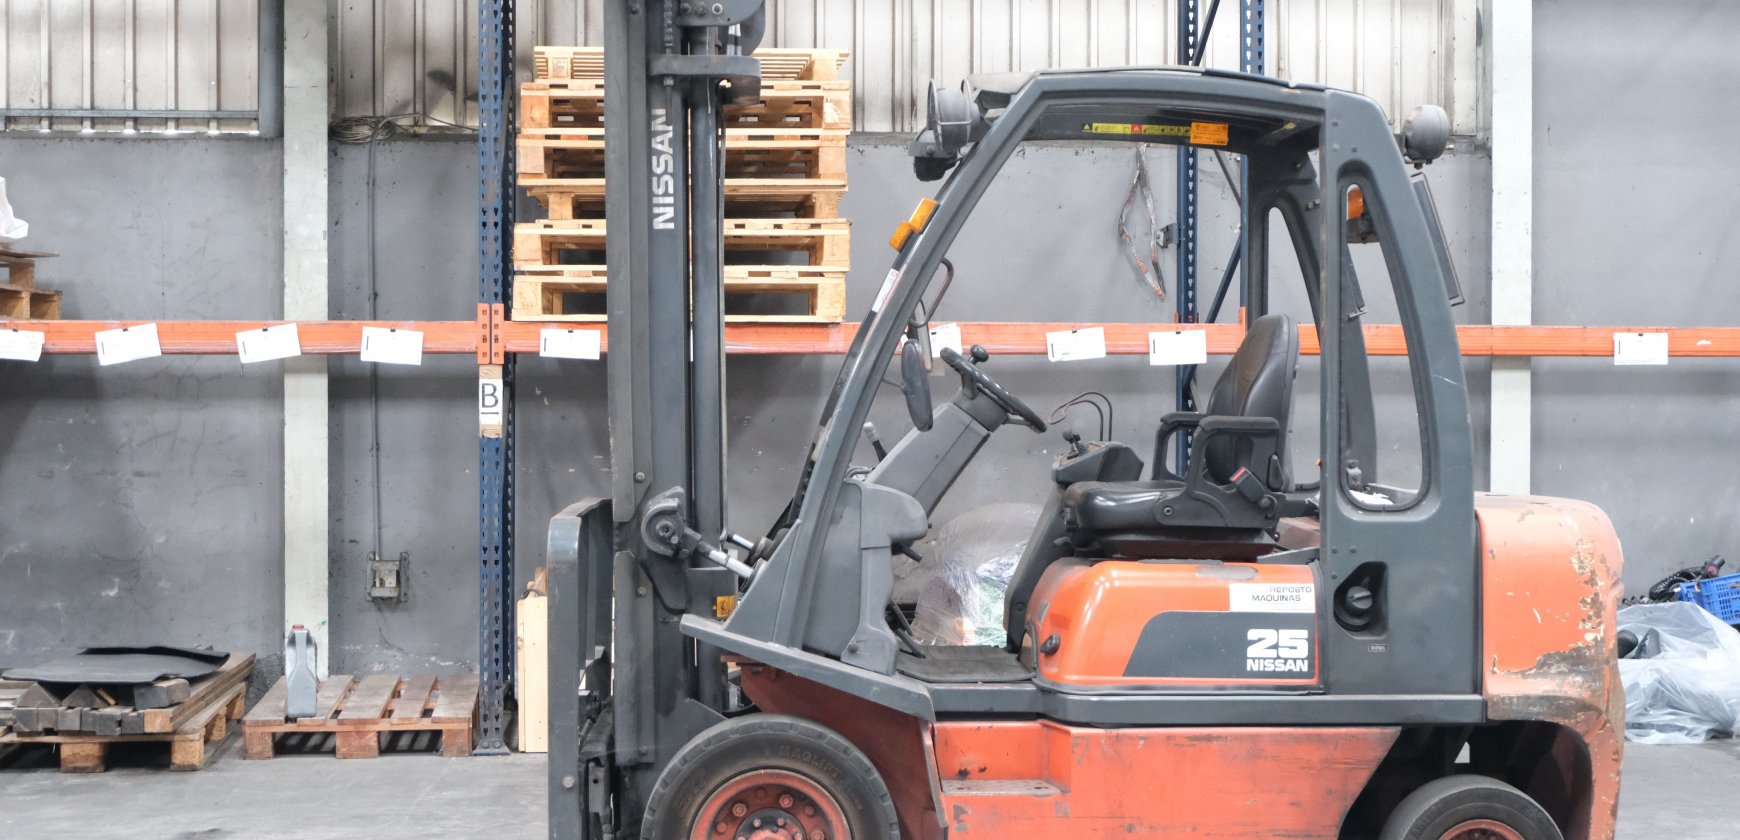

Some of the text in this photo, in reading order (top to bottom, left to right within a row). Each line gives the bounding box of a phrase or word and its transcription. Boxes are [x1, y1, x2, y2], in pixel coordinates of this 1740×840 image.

[651, 108, 675, 230] NISSAN
[481, 383, 499, 408] B
[1247, 629, 1309, 658] 25
[1247, 659, 1309, 672] NISSAN
